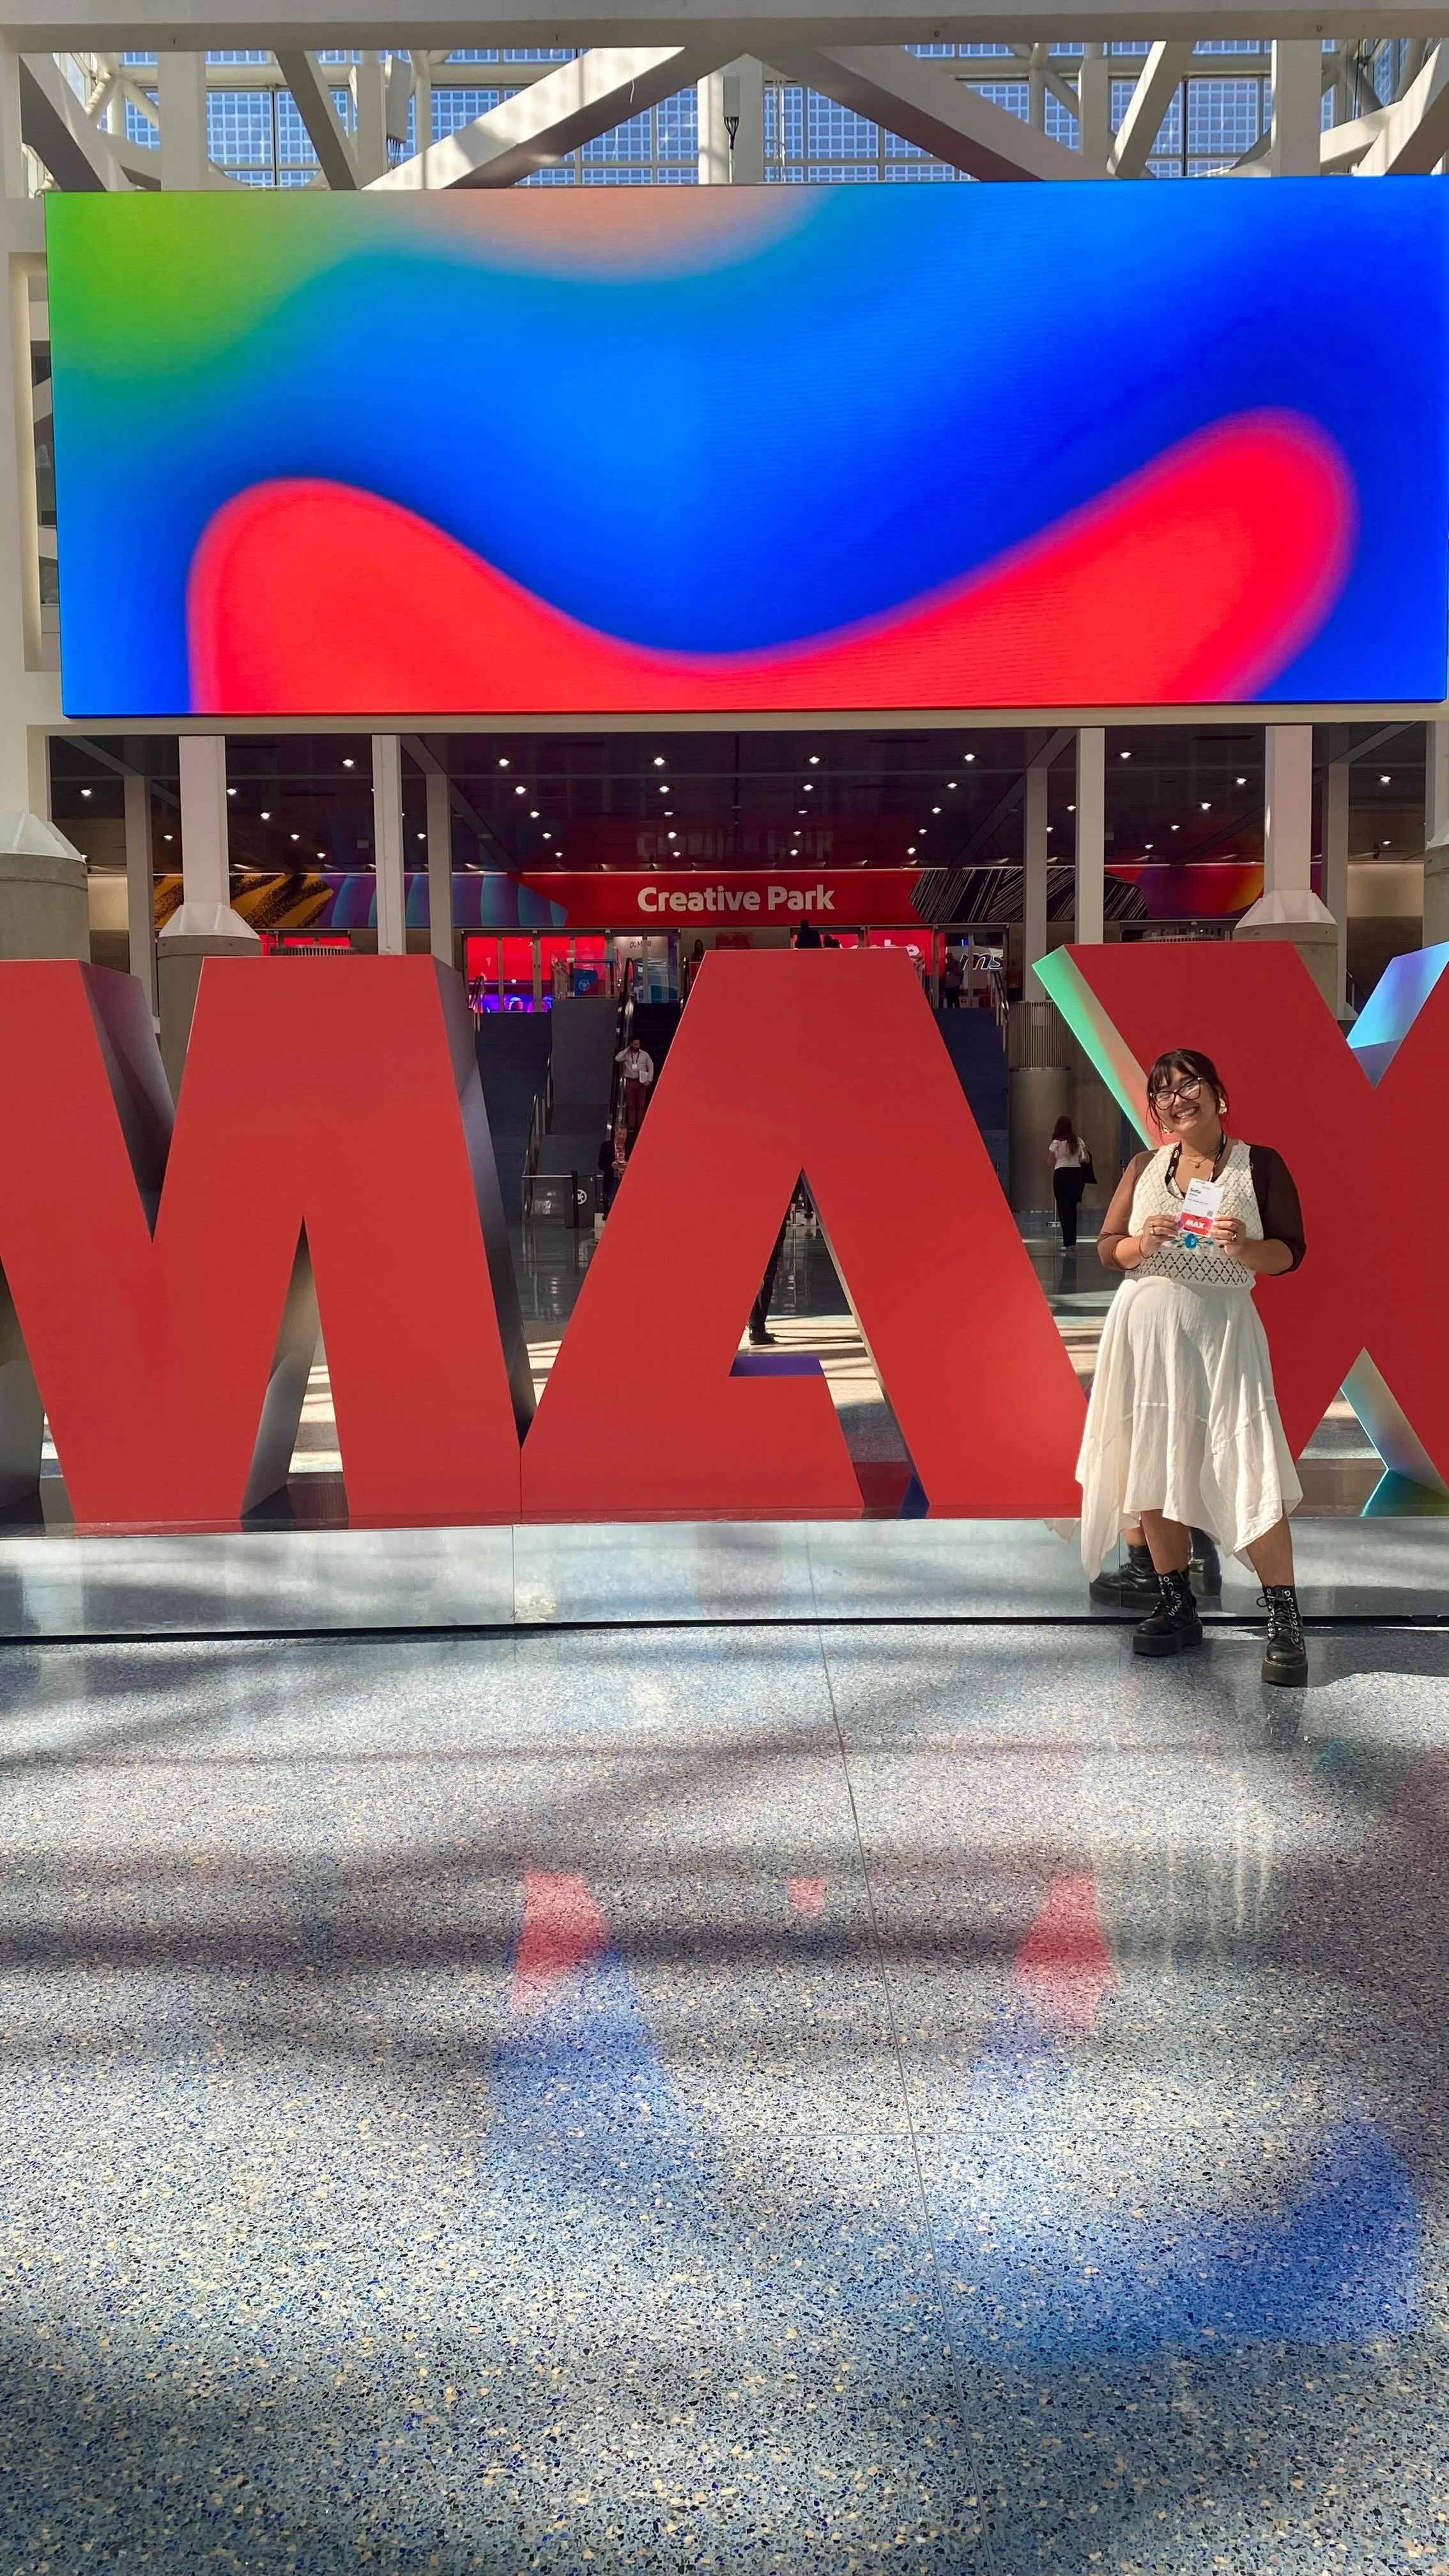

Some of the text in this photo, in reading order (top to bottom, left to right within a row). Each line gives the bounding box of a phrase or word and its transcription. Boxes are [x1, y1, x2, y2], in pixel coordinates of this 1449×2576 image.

[638, 885, 835, 912] Creative Park
[1185, 1219, 1205, 1229] MAX
